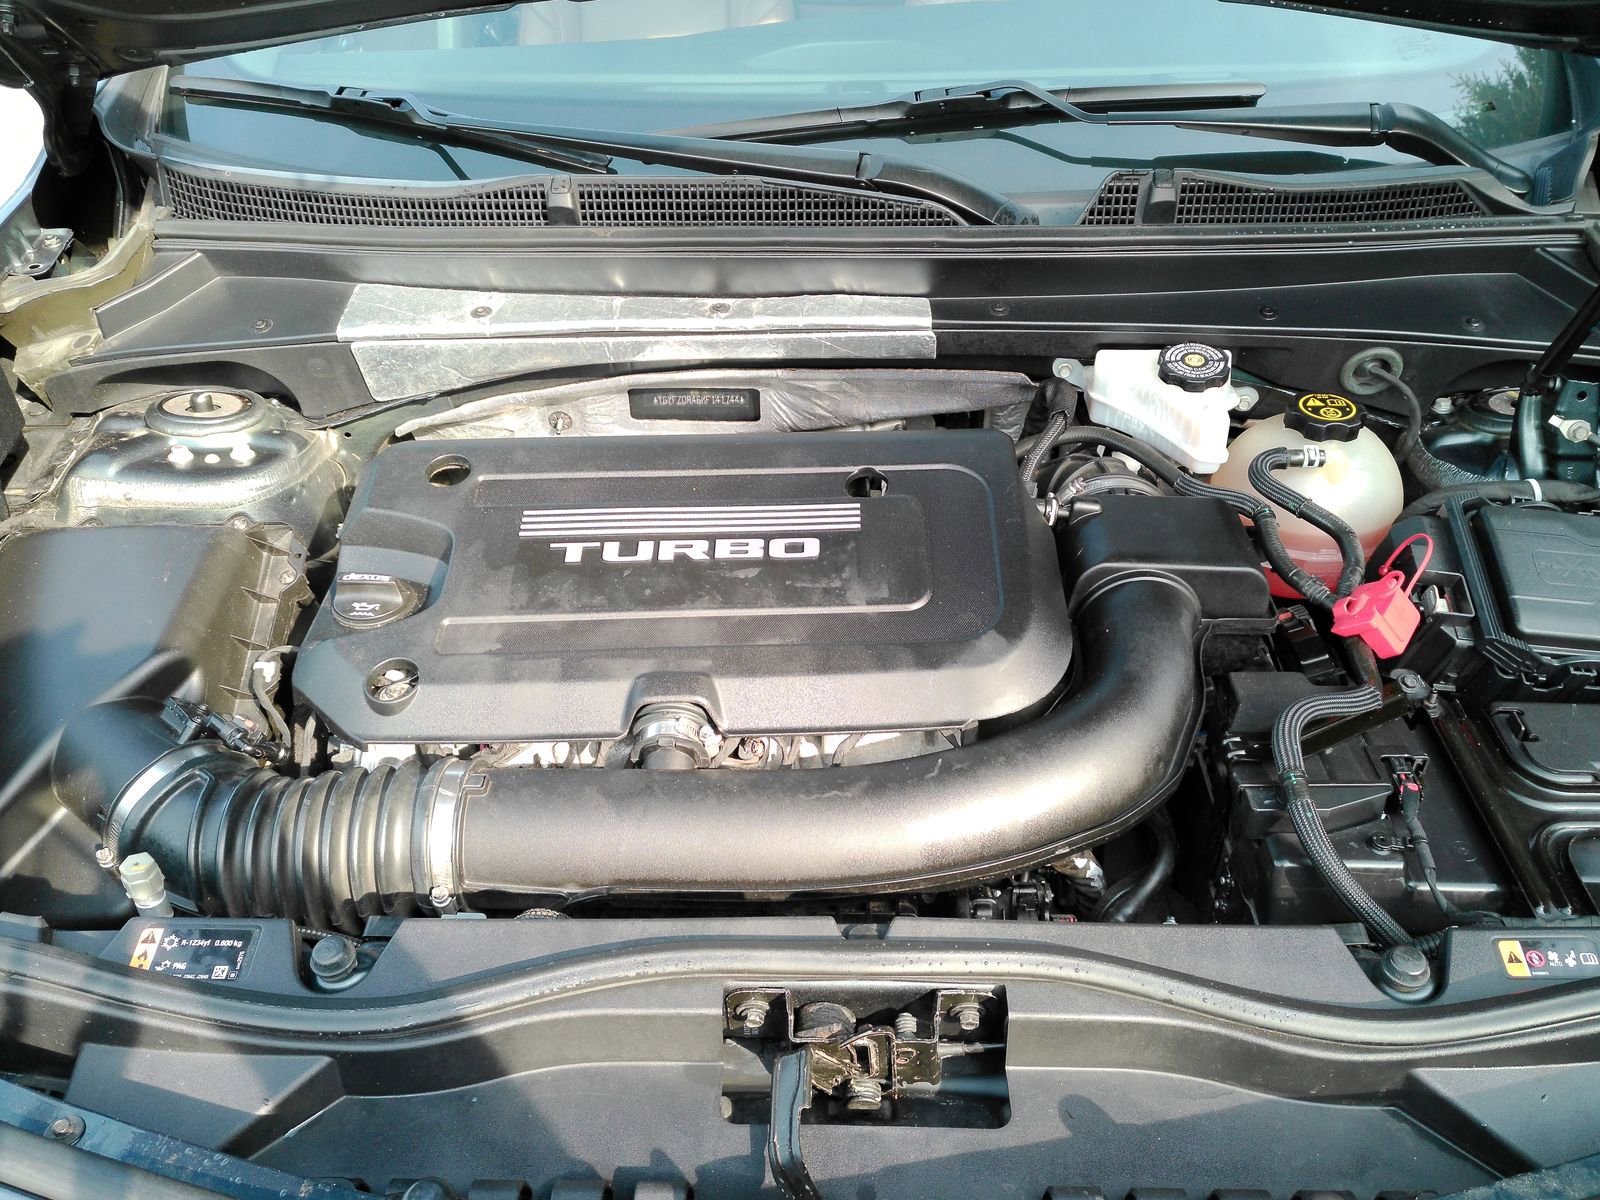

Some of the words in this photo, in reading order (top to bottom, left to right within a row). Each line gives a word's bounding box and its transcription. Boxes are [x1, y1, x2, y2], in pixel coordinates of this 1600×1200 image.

[549, 537, 821, 564] TURBO
[180, 939, 212, 948] R-1234yf
[214, 939, 233, 947] 0.600
[233, 939, 243, 948] kg
[172, 962, 187, 970] PAG
